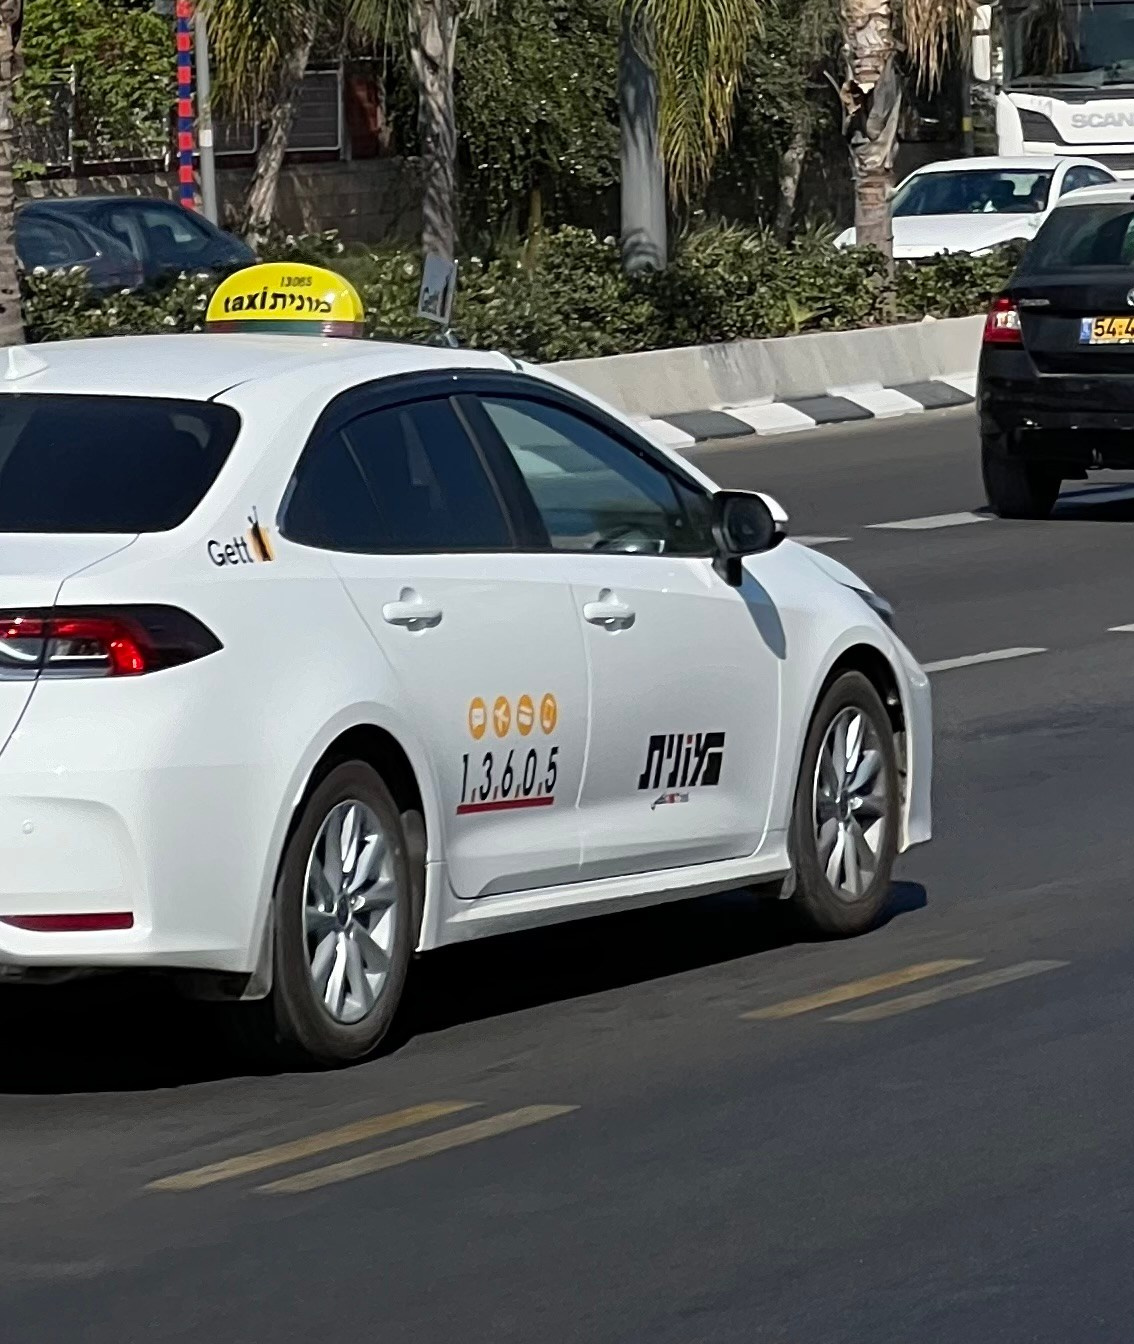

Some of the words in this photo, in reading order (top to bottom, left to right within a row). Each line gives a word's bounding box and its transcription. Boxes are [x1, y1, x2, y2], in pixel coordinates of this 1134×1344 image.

[224, 287, 267, 313] taxi
[271, 292, 331, 313] מונית
[207, 536, 254, 567] Gett
[638, 732, 725, 790] מונית
